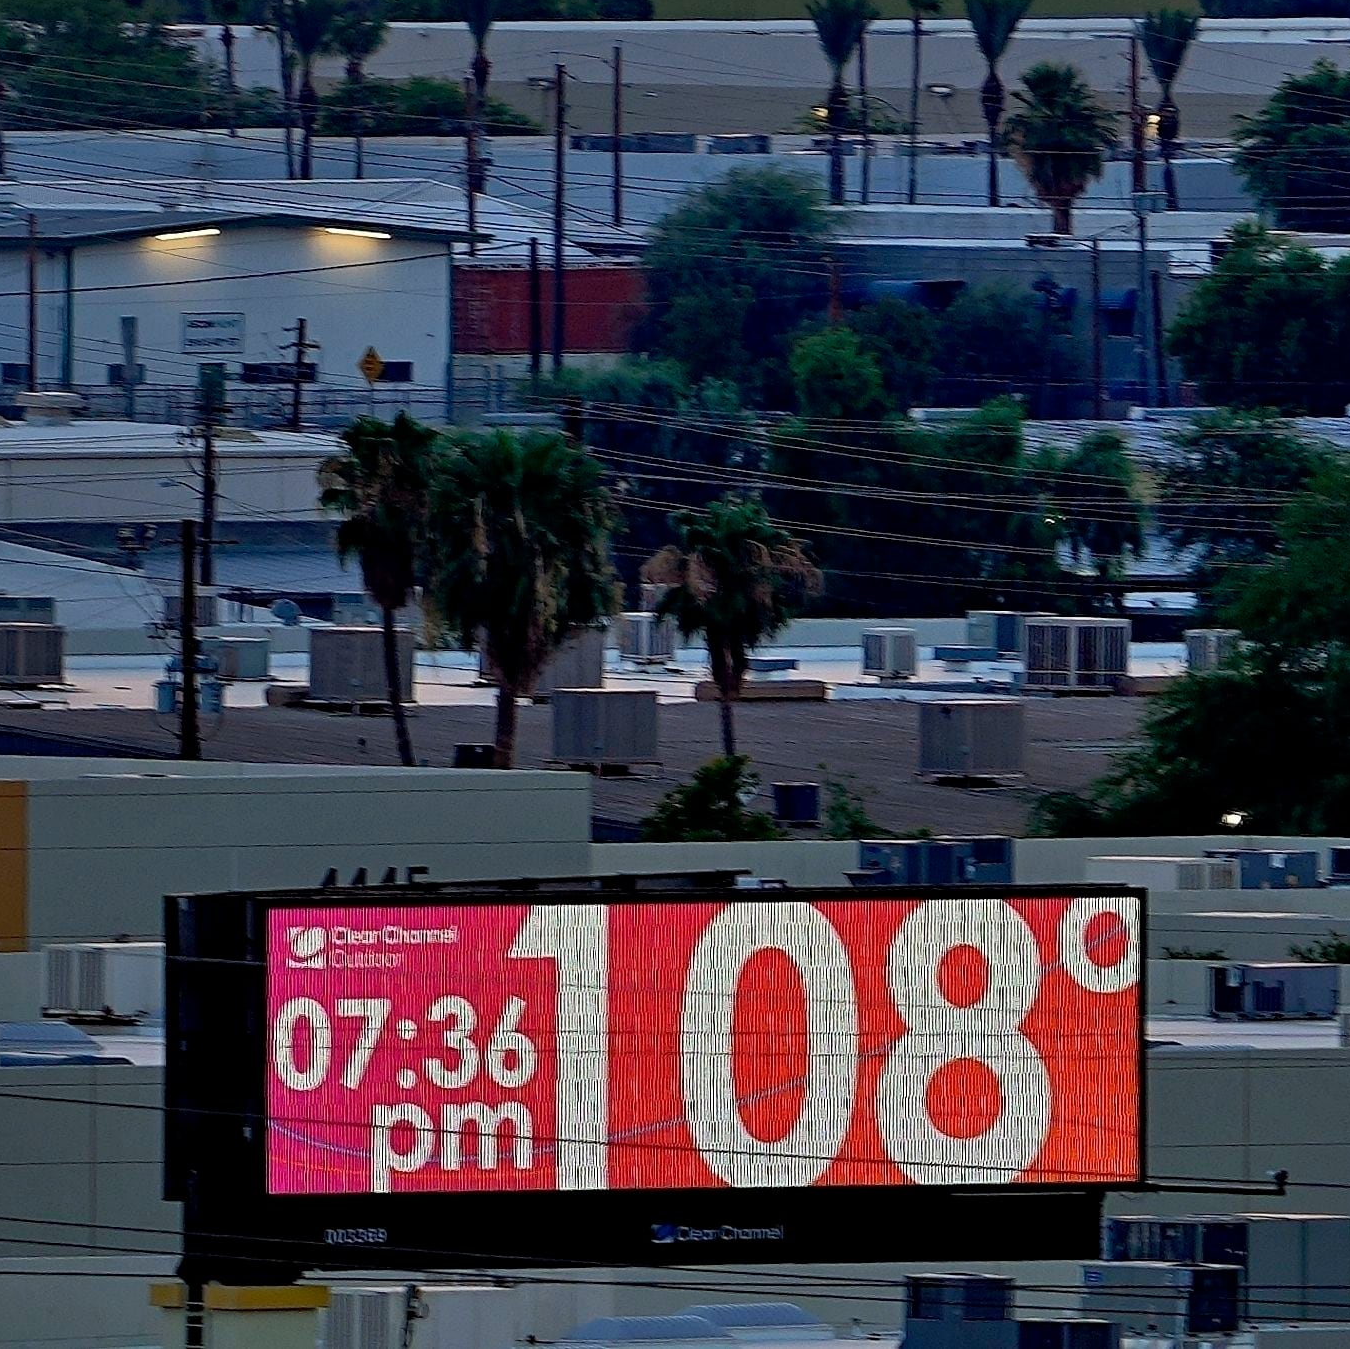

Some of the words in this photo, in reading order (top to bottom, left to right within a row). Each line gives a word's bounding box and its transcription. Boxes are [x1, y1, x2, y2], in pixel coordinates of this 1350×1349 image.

[331, 925, 381, 945] Clear
[382, 924, 459, 945] Channel
[331, 948, 402, 968] Outdoor
[272, 996, 537, 1093] 07:36
[372, 1102, 534, 1193] pm
[677, 1226, 718, 1241] Clear
[720, 1225, 784, 1241] Channel
